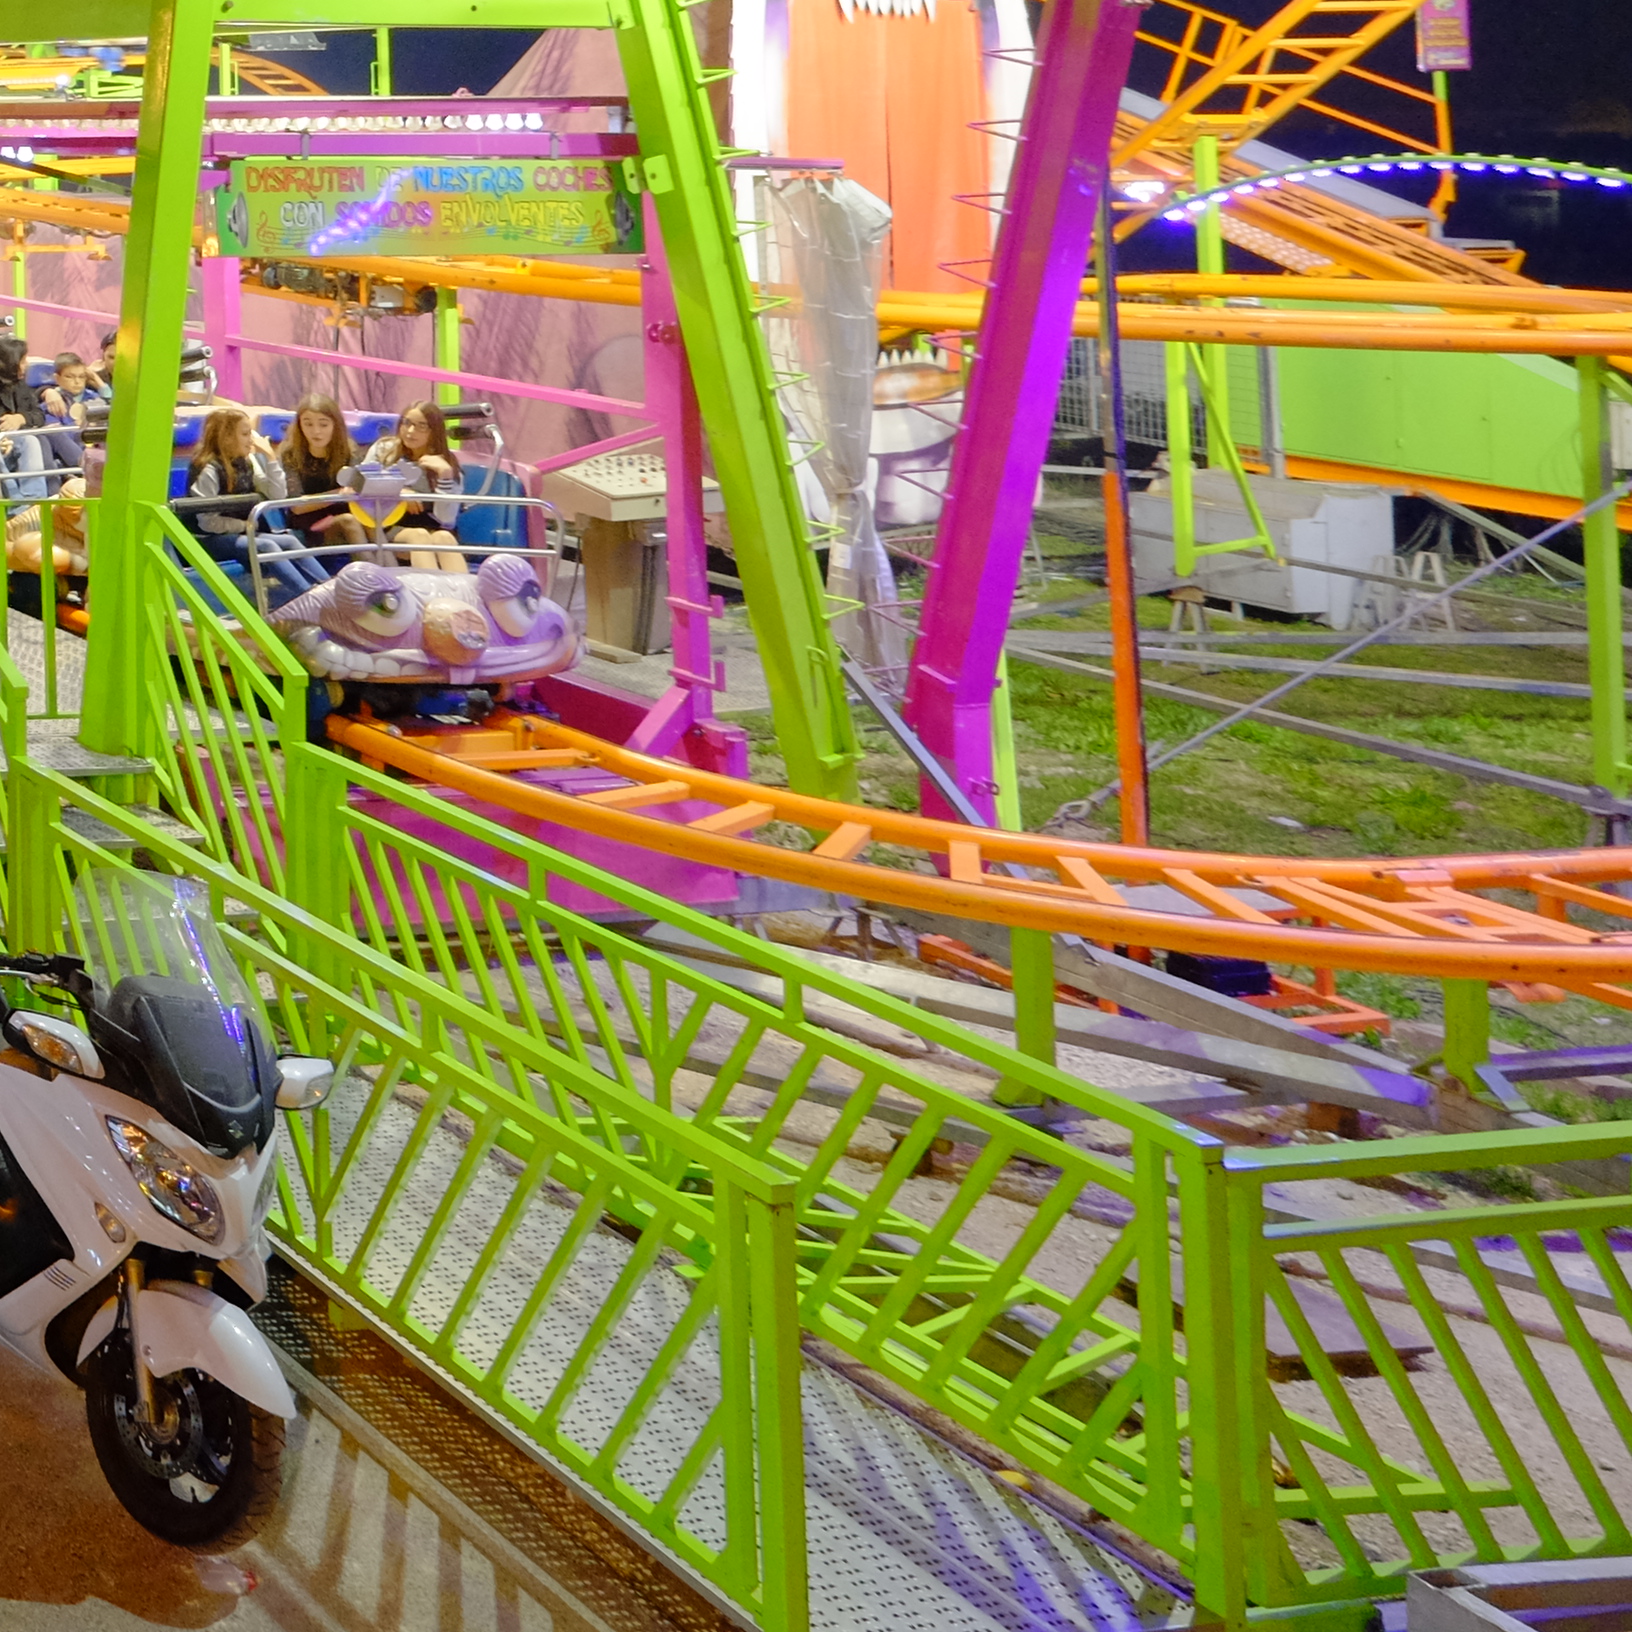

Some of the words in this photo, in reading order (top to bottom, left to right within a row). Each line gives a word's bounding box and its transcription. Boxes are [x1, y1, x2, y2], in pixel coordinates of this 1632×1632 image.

[245, 166, 365, 199] DISFRUTEN
[376, 166, 403, 192] DE
[413, 166, 524, 199] NUESTROS
[533, 166, 613, 192] COCHES
[280, 201, 324, 228] CON
[336, 200, 434, 228] SIDOS
[440, 192, 586, 228] ENVOLVENTES
